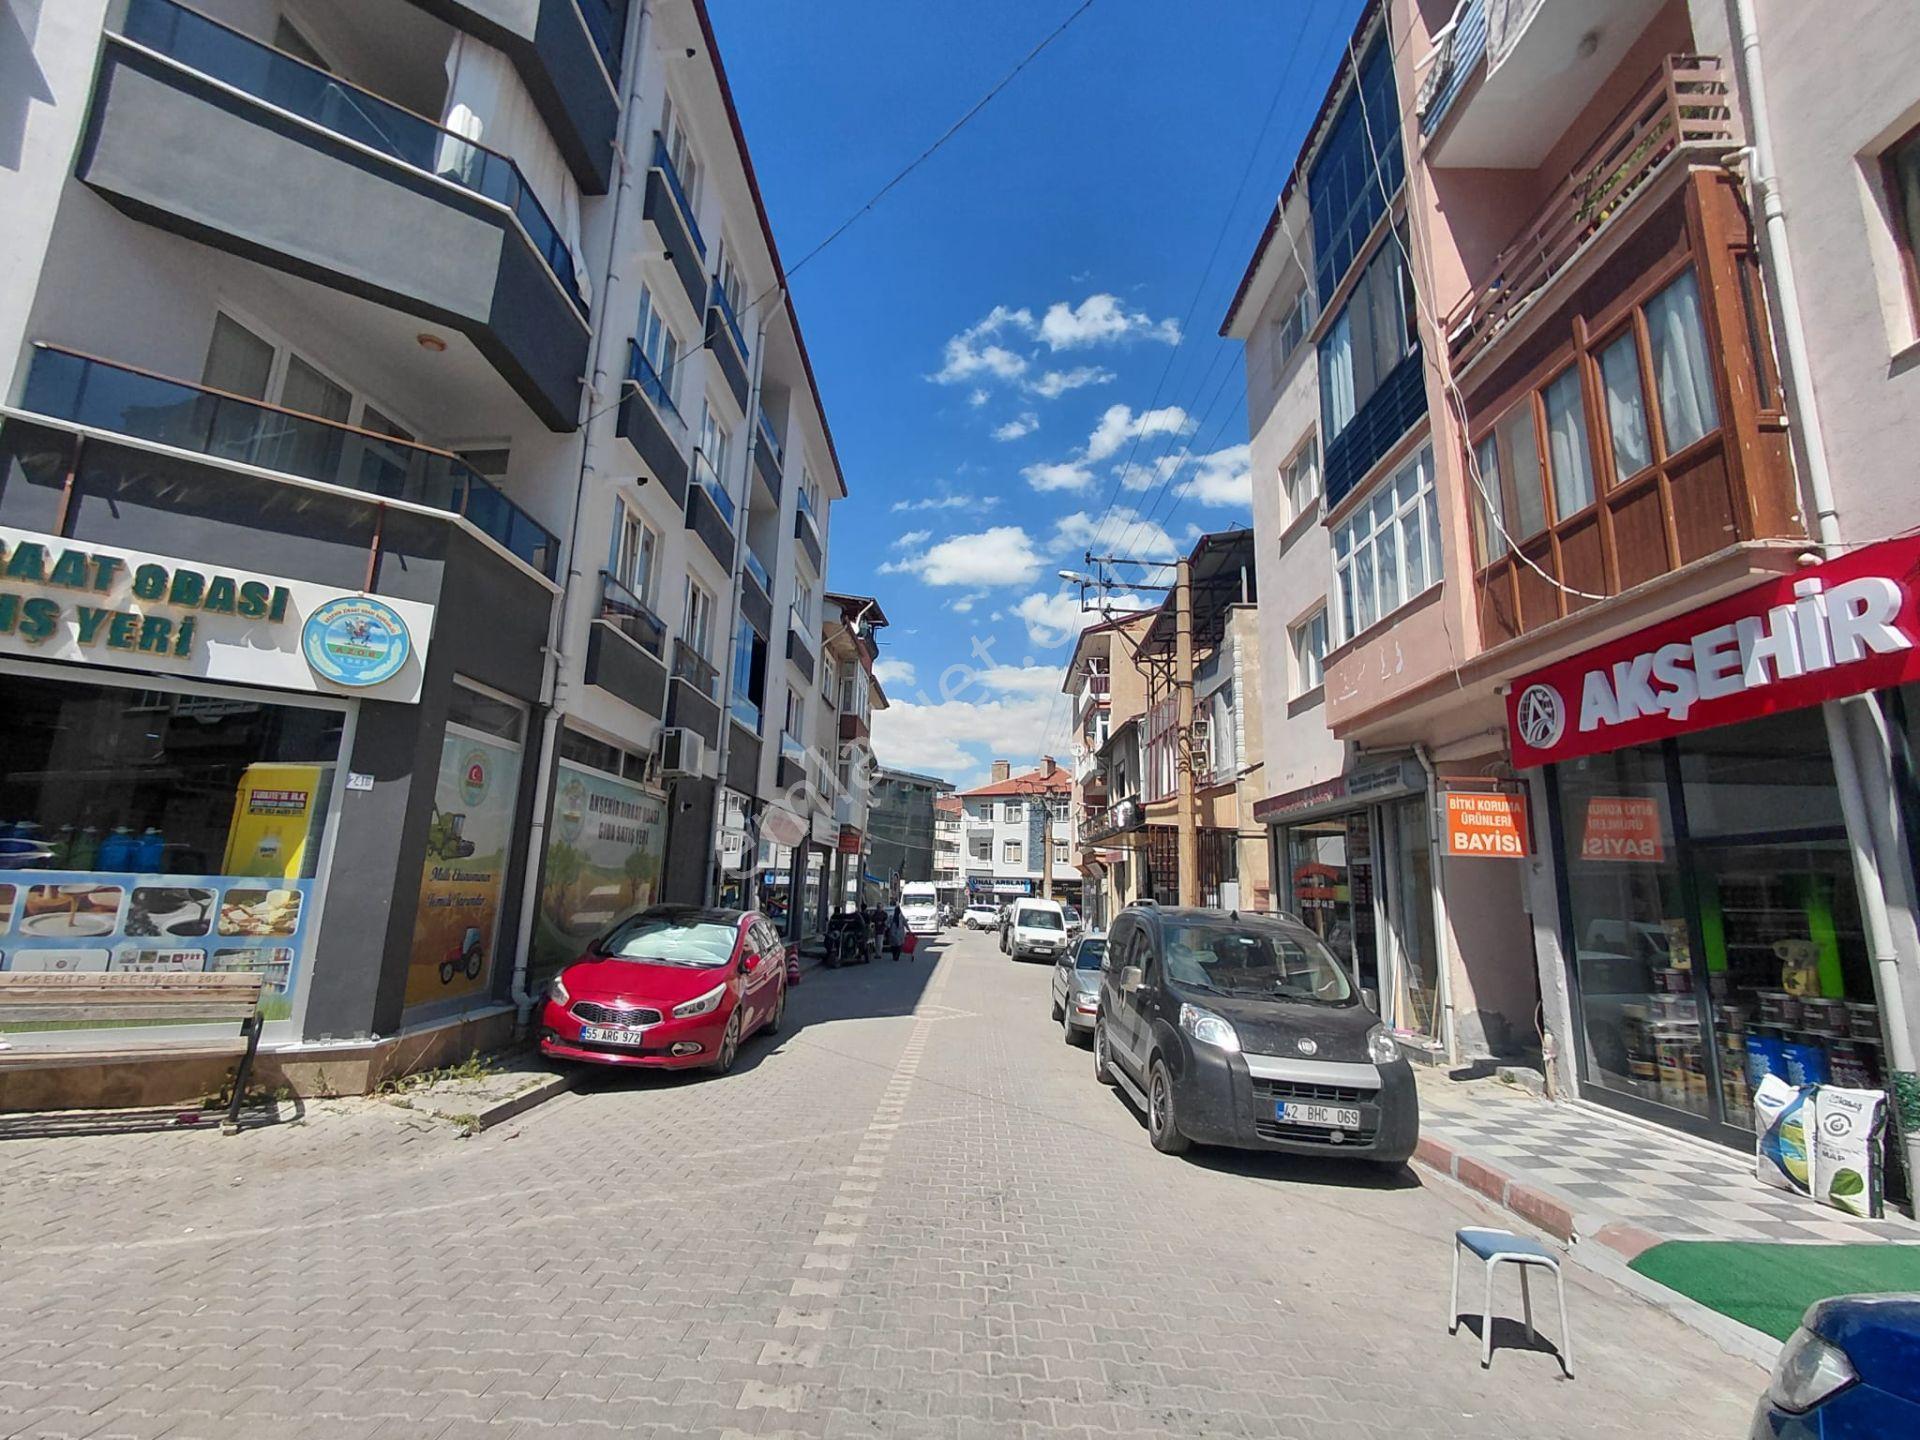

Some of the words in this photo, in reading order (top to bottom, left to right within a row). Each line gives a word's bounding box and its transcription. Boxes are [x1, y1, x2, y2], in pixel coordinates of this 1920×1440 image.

[77, 604, 196, 659] YERİ
[1579, 576, 1913, 732] AKŞEHİR
[1450, 796, 1475, 811] BİTKİ
[1478, 799, 1521, 813] KORUMA
[1461, 811, 1513, 827] ÜRÜNLERİ
[1454, 829, 1522, 853] BAYİSİ
[586, 1028, 597, 1040] 55
[601, 1030, 619, 1041] ARG
[623, 1032, 640, 1043] 972
[1284, 1104, 1298, 1119] 42
[1307, 1106, 1329, 1121] BHC
[1336, 1109, 1358, 1125] 069
